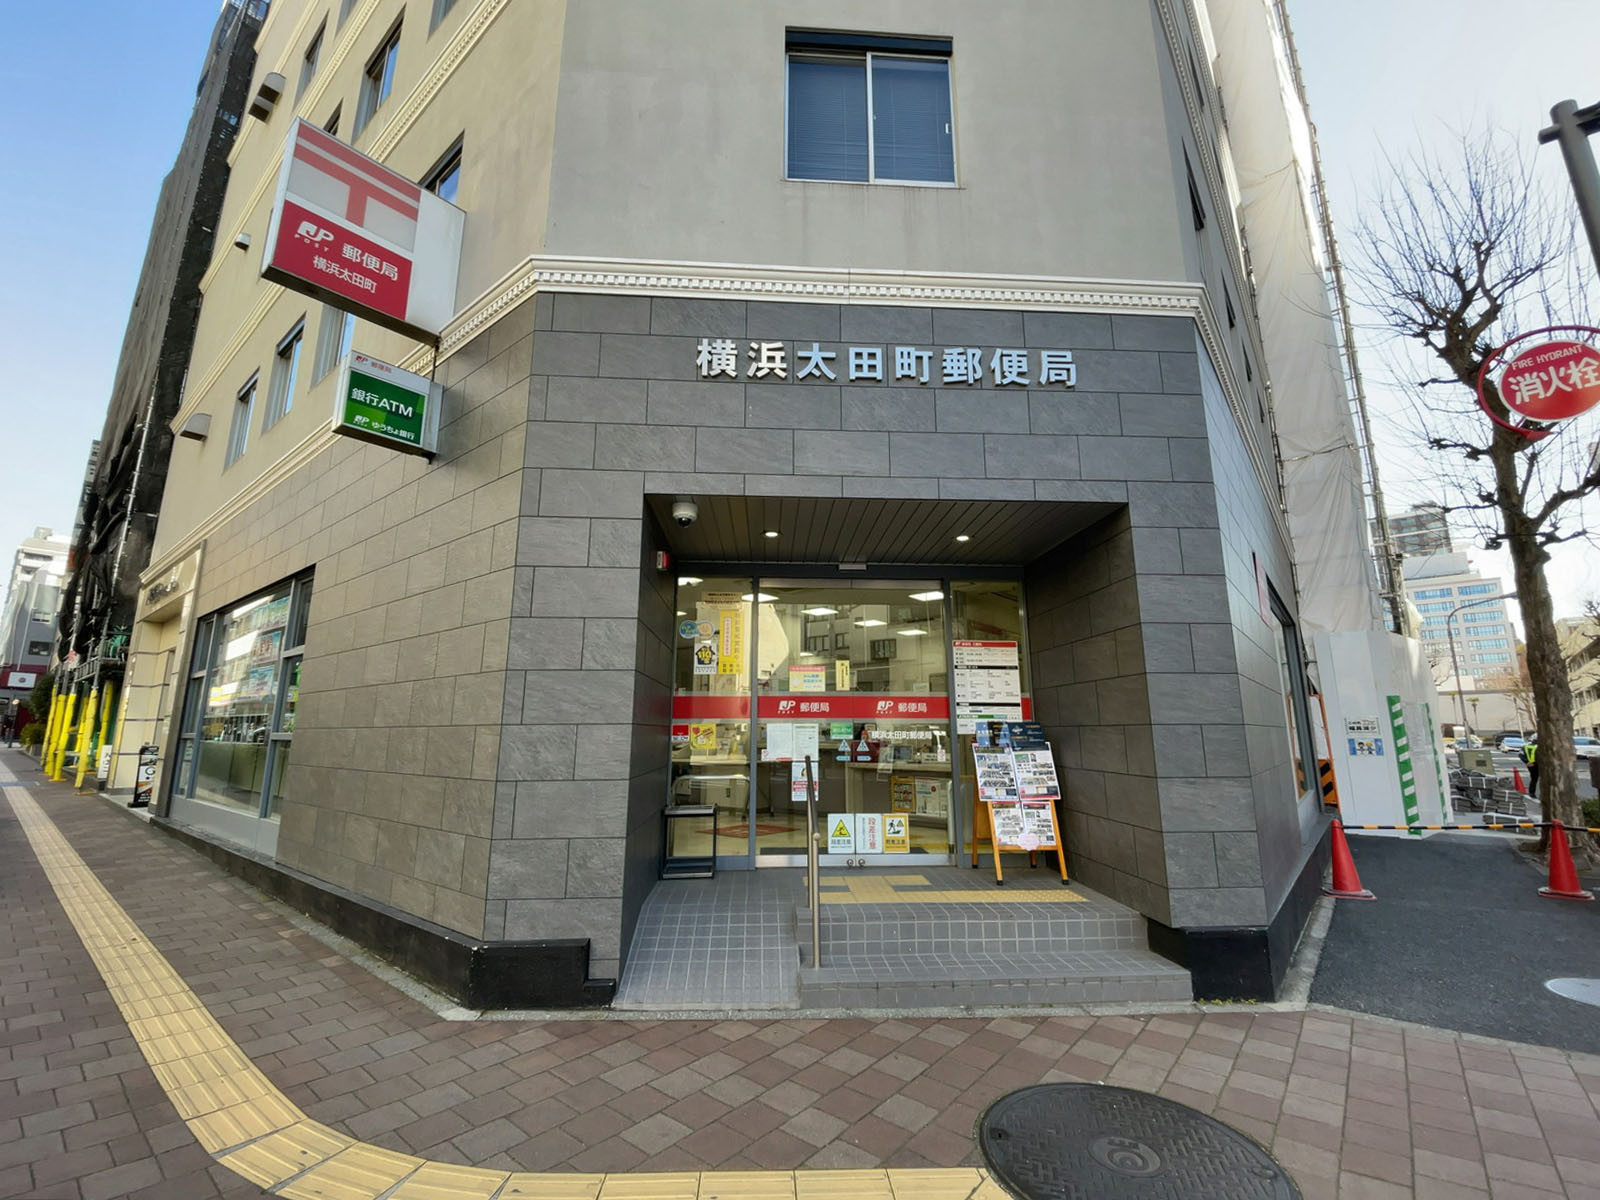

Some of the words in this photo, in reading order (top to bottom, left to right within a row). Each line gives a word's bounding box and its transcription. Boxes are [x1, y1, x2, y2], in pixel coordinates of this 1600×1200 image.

[312, 255, 377, 293] 横浜太田町
[341, 243, 398, 281] 郵便局
[696, 338, 1077, 388] 横浜太田町郵便局
[1511, 357, 1534, 371] FIRE
[1536, 344, 1582, 364] HYDRANT
[1508, 357, 1600, 405] 消火栓
[351, 387, 413, 418] 銀行ATM
[371, 421, 415, 440] ゆうちょ銀行
[799, 702, 830, 713] 郵便局
[898, 702, 928, 713] 郵便局
